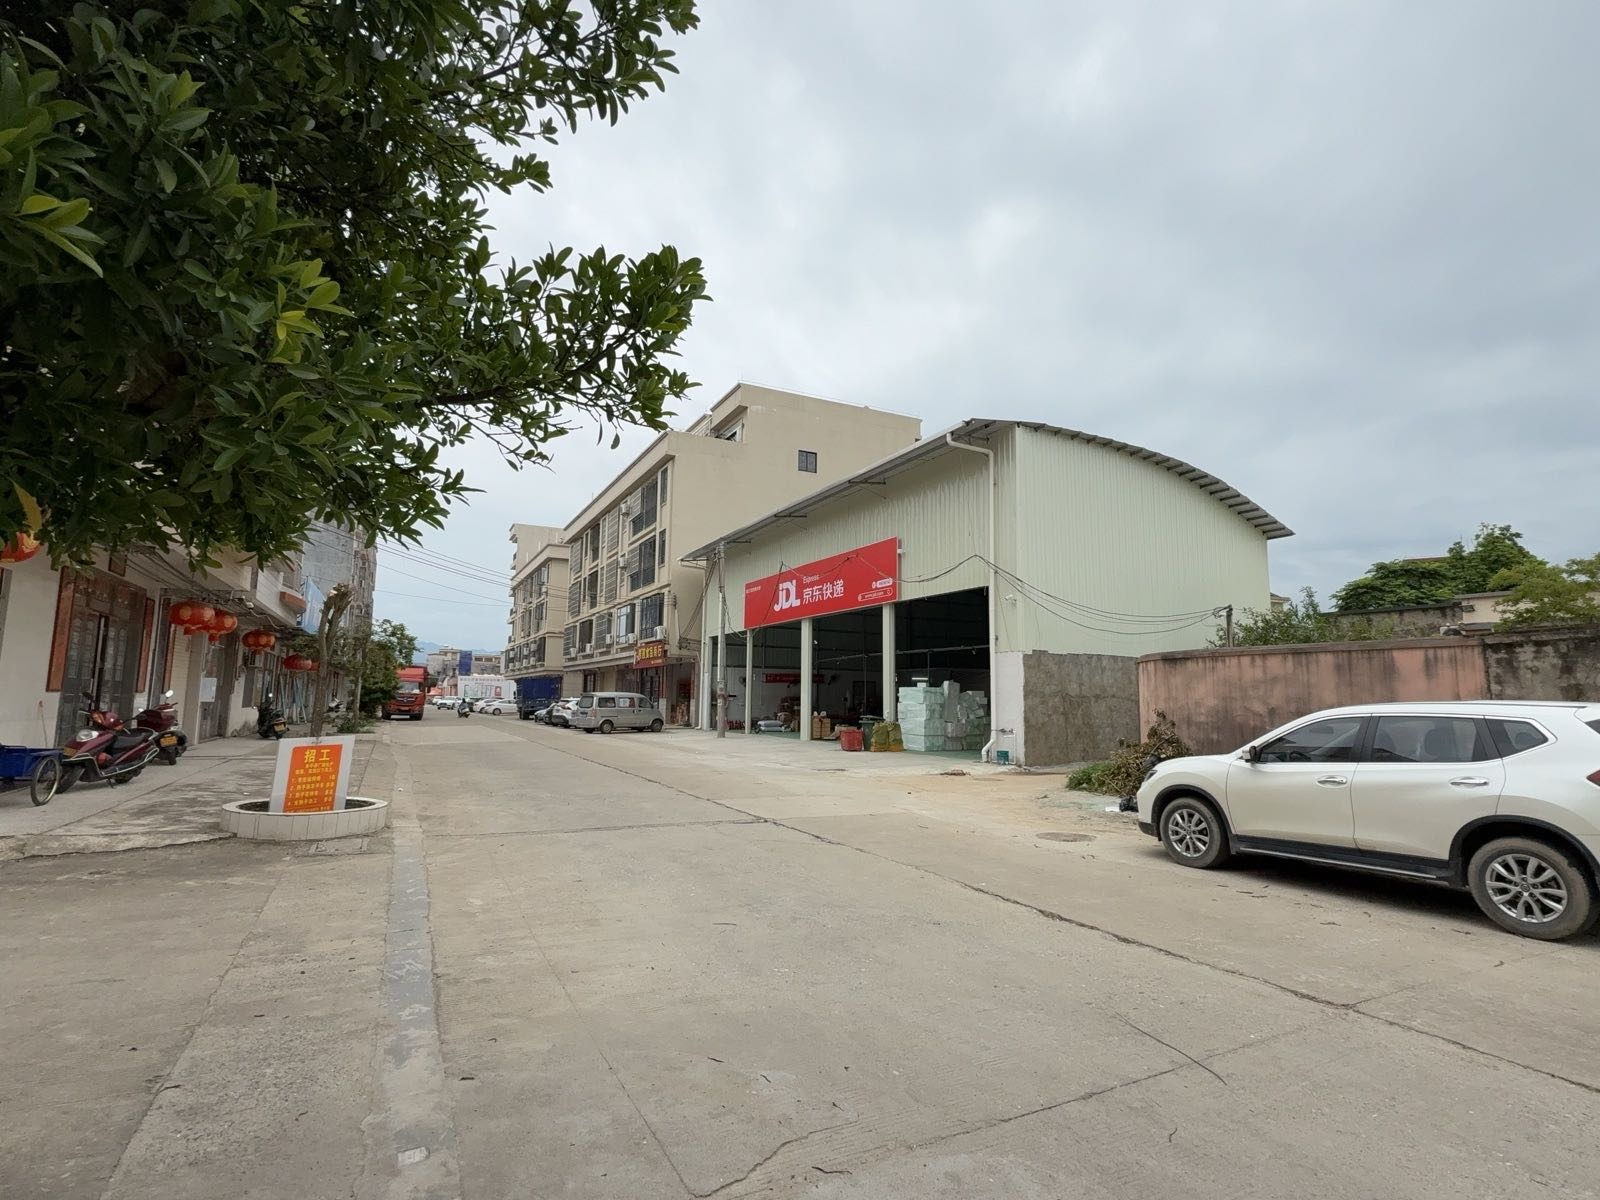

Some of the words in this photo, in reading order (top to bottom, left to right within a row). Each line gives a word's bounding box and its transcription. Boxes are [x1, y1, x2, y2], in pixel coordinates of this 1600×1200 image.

[773, 579, 801, 612] JDL
[802, 579, 844, 605] 京东快递
[304, 749, 331, 763] 招工
